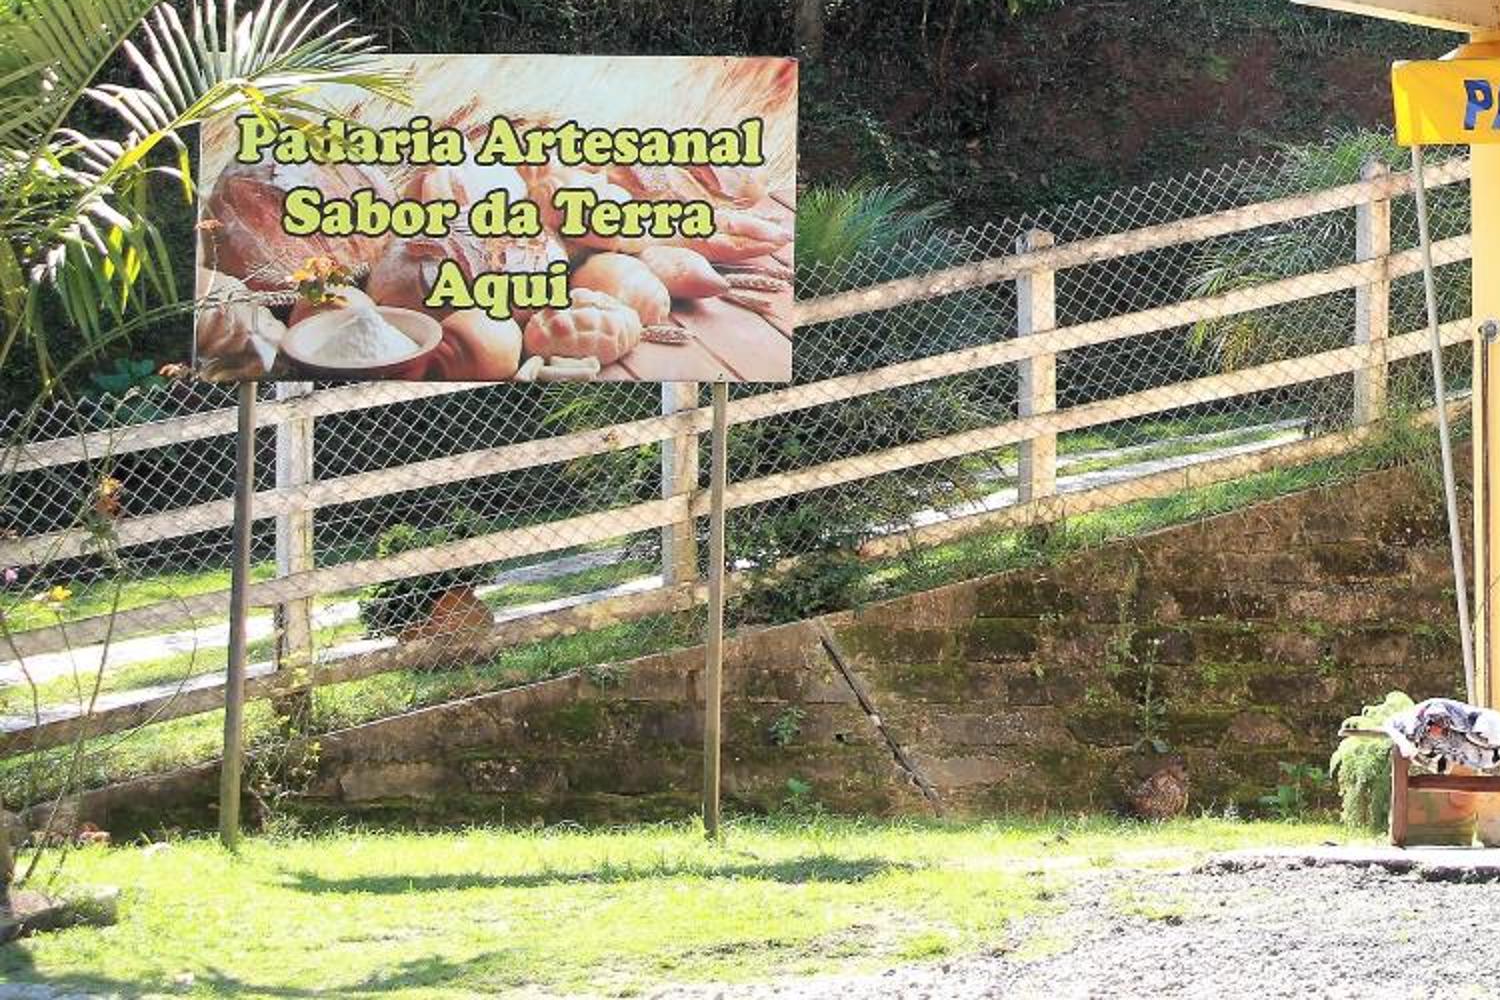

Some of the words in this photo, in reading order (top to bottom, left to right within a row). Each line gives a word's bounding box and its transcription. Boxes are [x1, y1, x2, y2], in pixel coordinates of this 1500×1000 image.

[236, 114, 466, 166] Padaria
[474, 115, 764, 166] Artesanal
[282, 186, 459, 238] Sabor
[468, 187, 542, 238] da
[553, 187, 716, 238] Terra
[424, 259, 571, 320] Aqui
